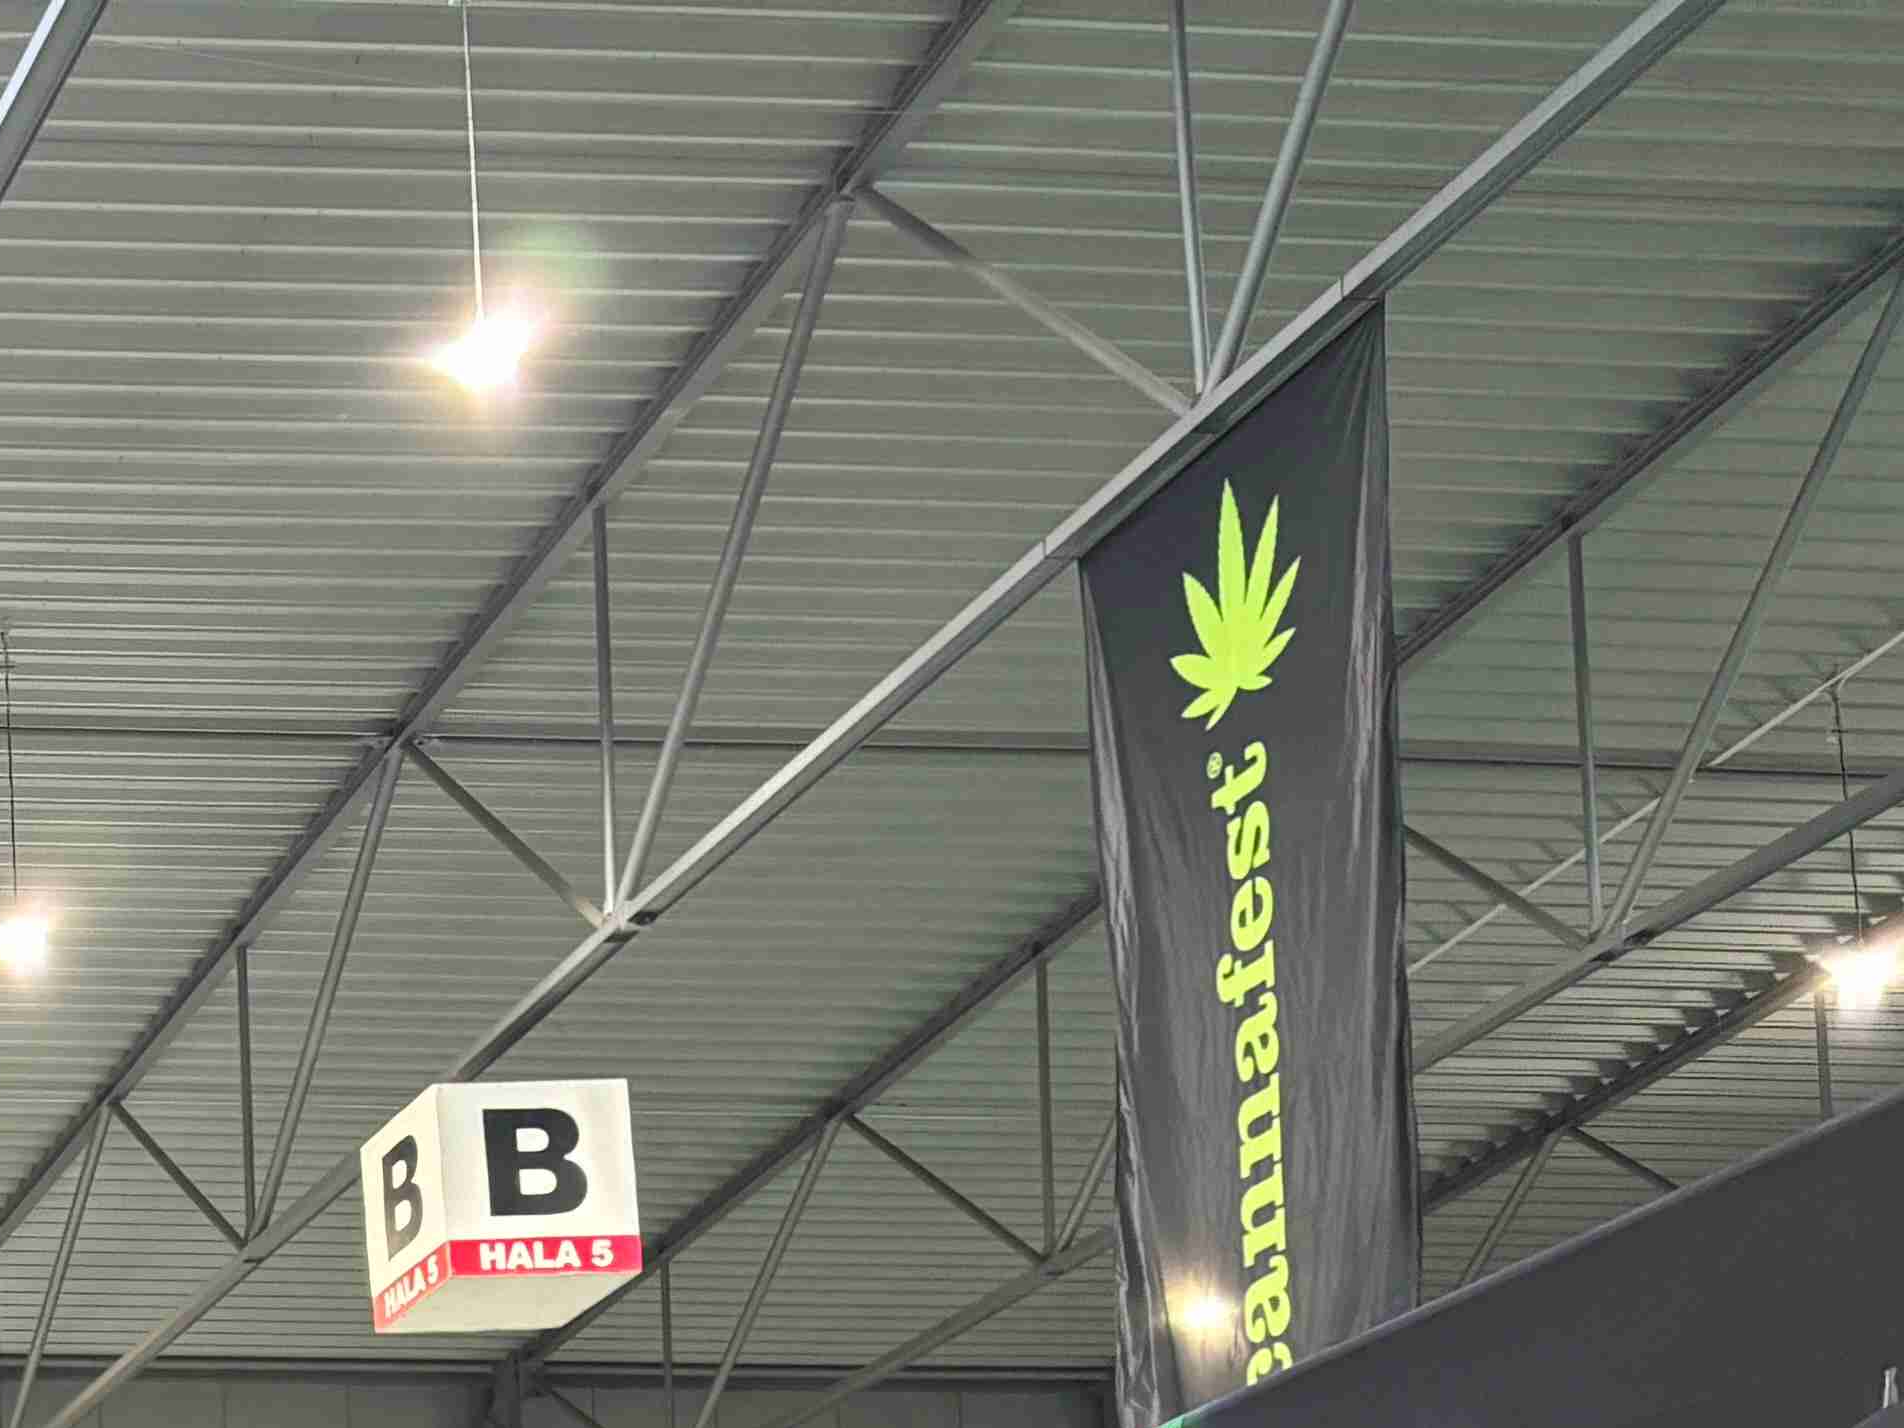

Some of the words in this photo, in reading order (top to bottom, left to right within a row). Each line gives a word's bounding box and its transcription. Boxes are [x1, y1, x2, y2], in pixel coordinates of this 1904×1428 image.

[381, 1134, 424, 1262] B
[481, 1107, 589, 1218] B
[382, 1266, 428, 1320] HALA
[427, 1254, 441, 1286] 5
[478, 1240, 582, 1272] HALA
[591, 1238, 615, 1268] 5
